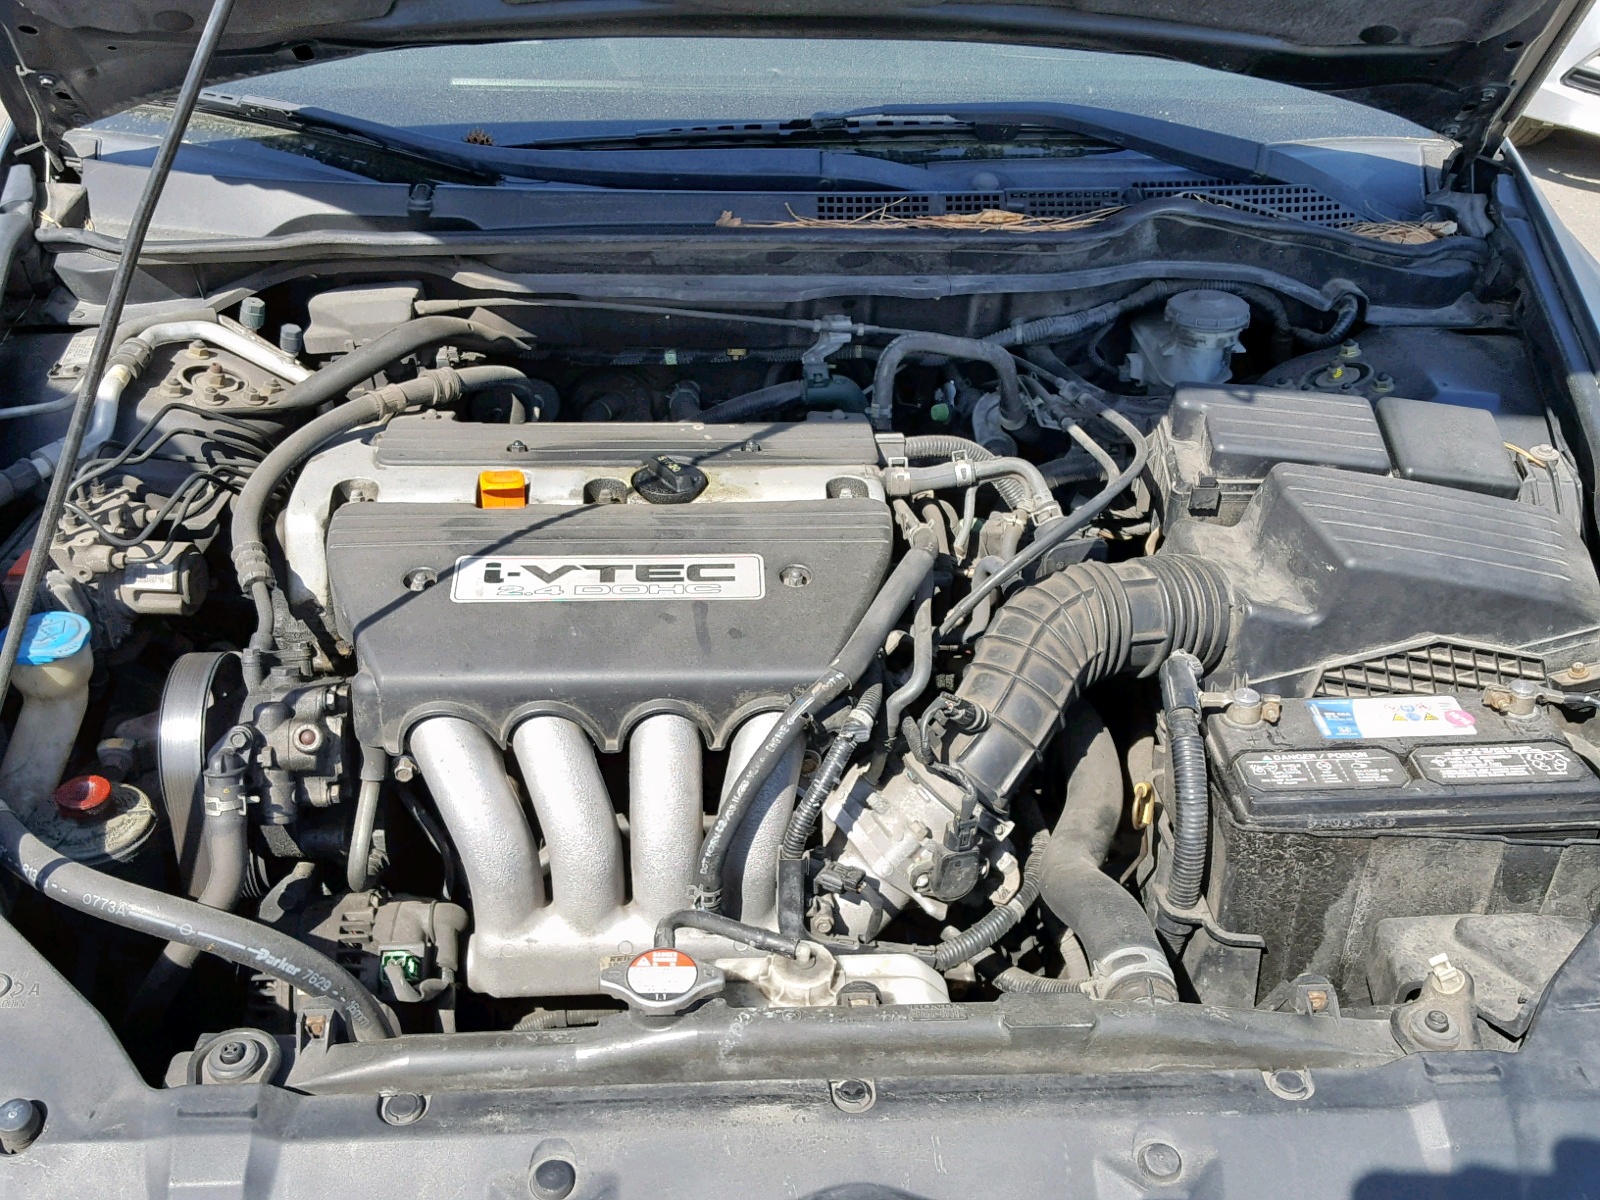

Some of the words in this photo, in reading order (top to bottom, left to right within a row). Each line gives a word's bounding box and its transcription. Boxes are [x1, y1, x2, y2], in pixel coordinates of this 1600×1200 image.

[483, 562, 736, 584] i-VTEC
[496, 585, 564, 596] 2.4
[573, 583, 722, 596] DOHC
[764, 724, 790, 753] ENGINE
[1273, 753, 1317, 762] DANGER
[1326, 751, 1369, 760] POISON
[82, 893, 127, 917] 0773A
[255, 947, 301, 976] Parker
[301, 968, 332, 992] 7629
